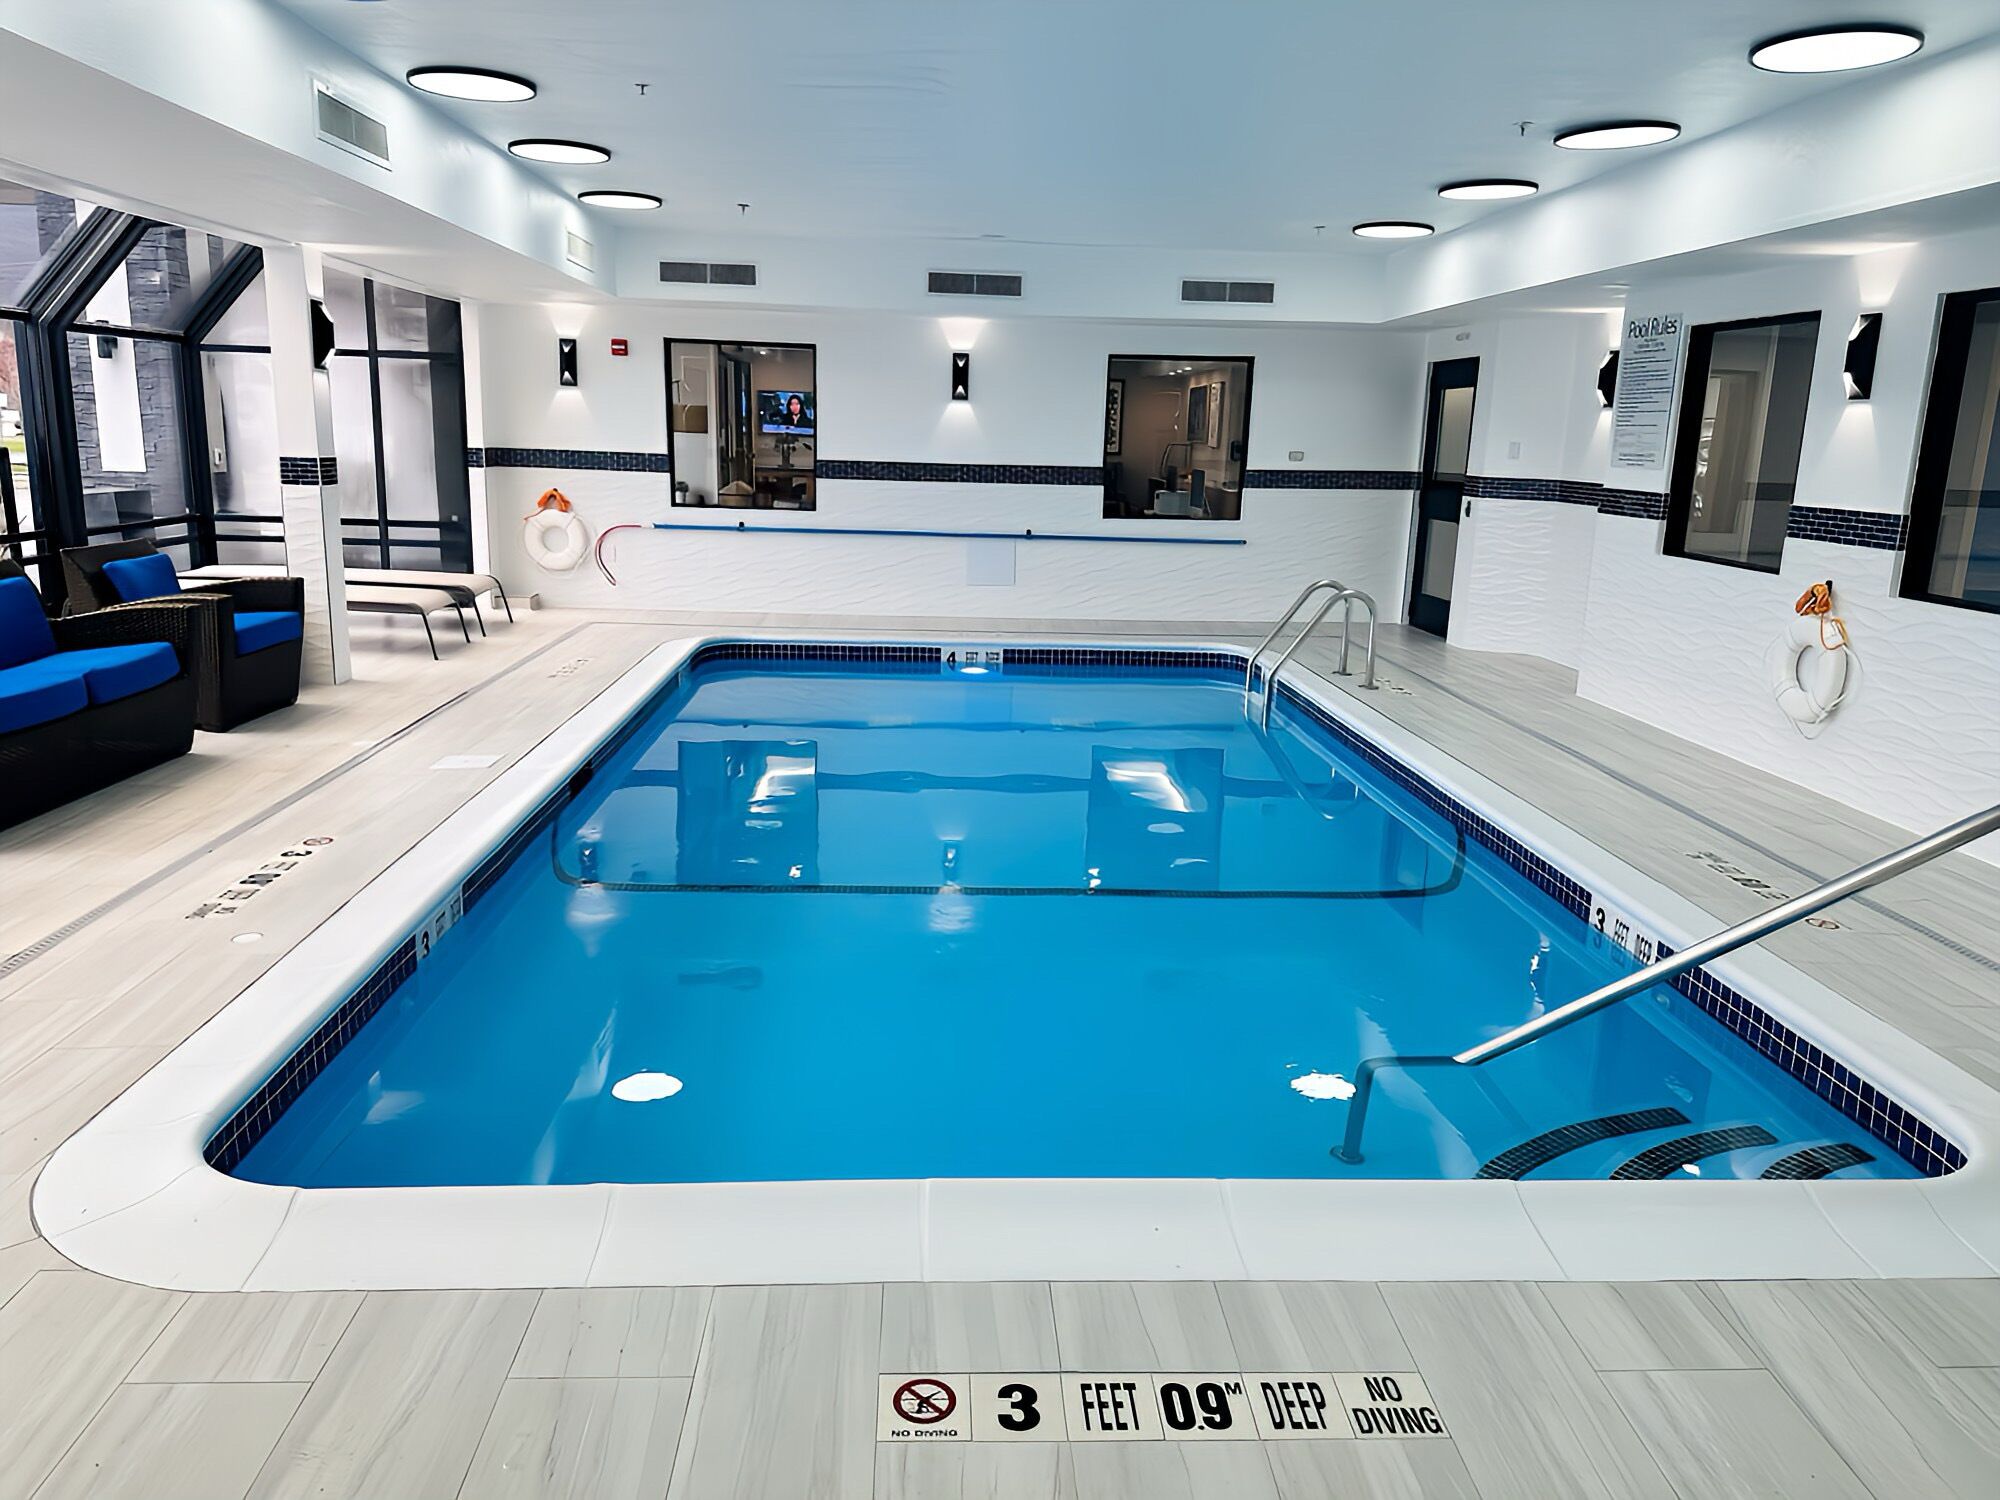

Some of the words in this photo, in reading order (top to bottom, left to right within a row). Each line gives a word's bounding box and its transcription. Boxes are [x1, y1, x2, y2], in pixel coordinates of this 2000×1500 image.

[1627, 317, 1652, 339] Pool
[1650, 314, 1678, 336] Rules
[946, 651, 956, 662] 4
[1594, 907, 1606, 934] 3
[421, 930, 430, 959] 3
[1363, 1376, 1403, 1402] NO
[997, 1383, 1041, 1432] 3
[1080, 1382, 1140, 1431] FEET
[1260, 1382, 1327, 1430] DEEP
[1352, 1406, 1444, 1434] DIVING
